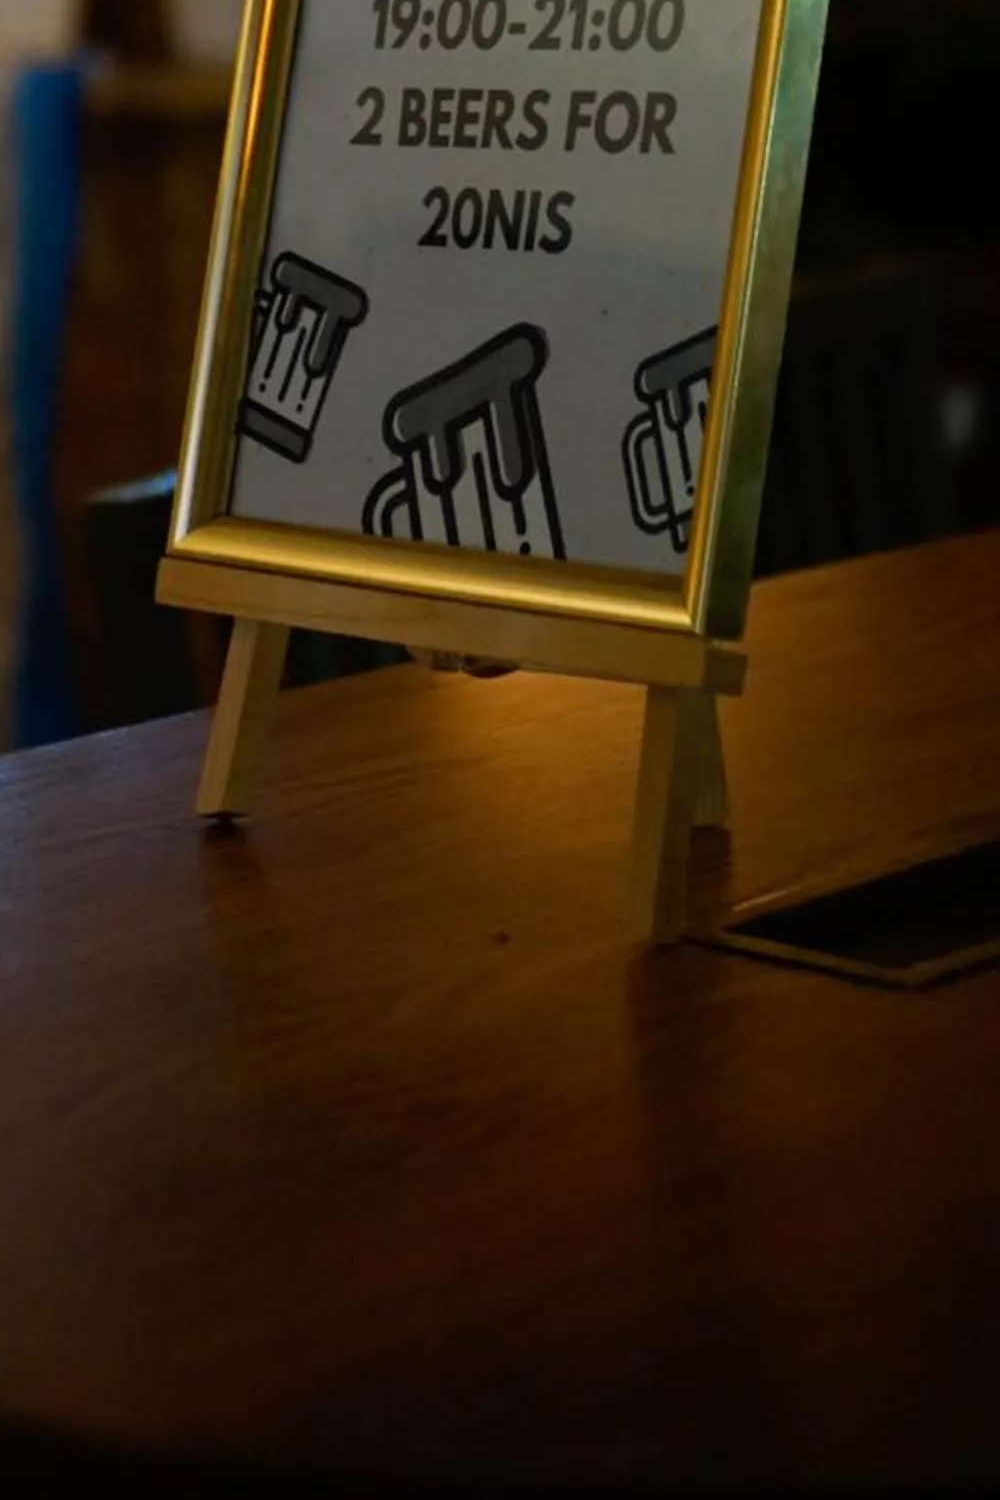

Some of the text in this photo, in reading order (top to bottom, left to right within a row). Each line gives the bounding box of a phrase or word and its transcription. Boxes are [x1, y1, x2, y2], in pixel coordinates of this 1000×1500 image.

[349, 86, 677, 154] 2 BEERS FOR
[418, 186, 575, 254] 20NIS
